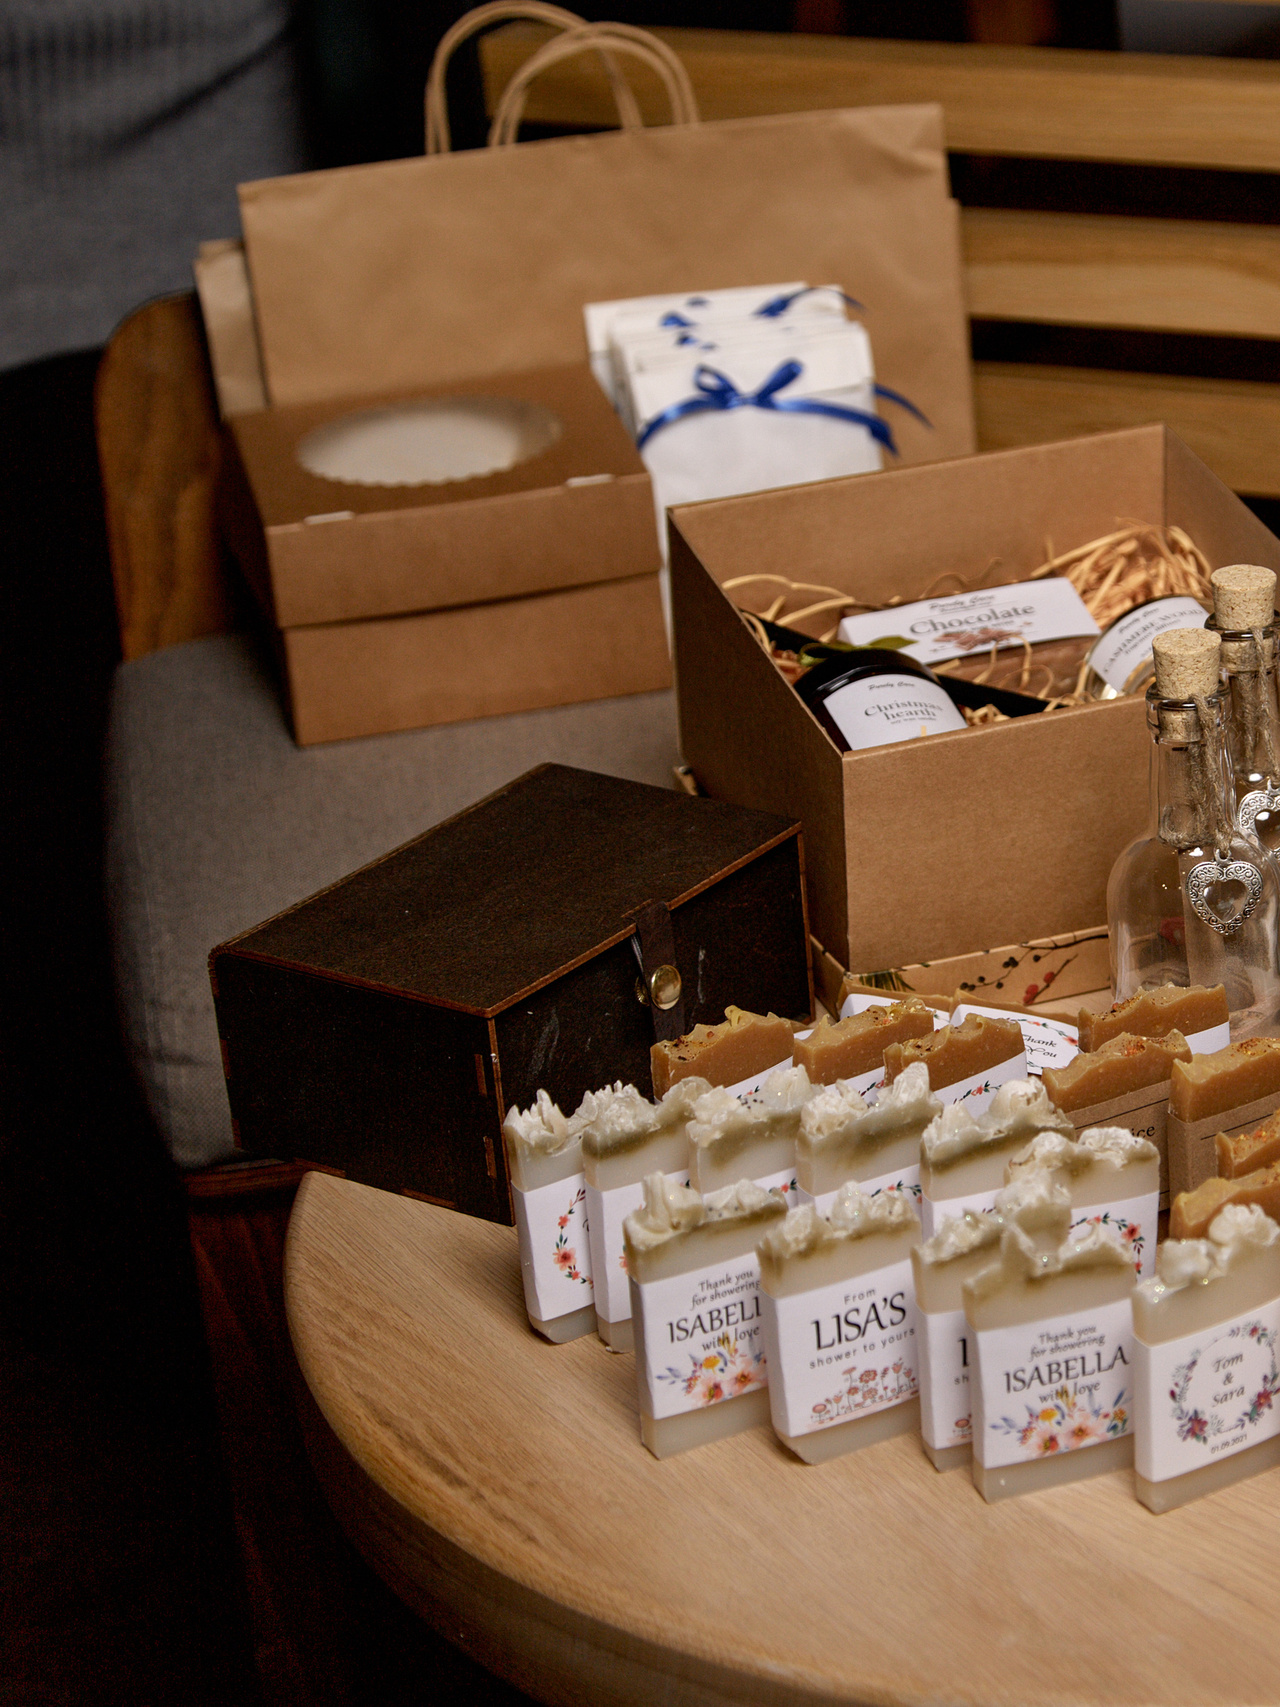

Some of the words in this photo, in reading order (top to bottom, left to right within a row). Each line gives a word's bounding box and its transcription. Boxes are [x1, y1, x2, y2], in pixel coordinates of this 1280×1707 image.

[908, 605, 1036, 635] Chocolate
[864, 699, 944, 717] Christmas
[883, 708, 938, 721] hearth
[698, 1272, 733, 1293] Thank
[734, 1270, 754, 1286] you
[690, 1294, 707, 1312] for
[709, 1280, 761, 1302] showering
[843, 1288, 876, 1305] From
[666, 1295, 762, 1344] ISABELL
[810, 1291, 907, 1352] LISA'S
[701, 1331, 730, 1352] with
[733, 1326, 760, 1342] love
[1038, 1326, 1074, 1345] Thank
[1077, 1324, 1097, 1341] you
[809, 1348, 857, 1370] shower
[863, 1342, 876, 1353] to
[880, 1328, 916, 1349] yours
[1028, 1346, 1047, 1363] for
[1049, 1333, 1106, 1355] showering
[1003, 1345, 1130, 1395] ISABELLA
[1212, 1353, 1244, 1373] Tom
[1222, 1372, 1234, 1386] &
[1038, 1387, 1070, 1404] with
[1073, 1380, 1101, 1396] love
[1211, 1386, 1245, 1408] Sara
[1210, 1434, 1248, 1454] 01.09.2021
